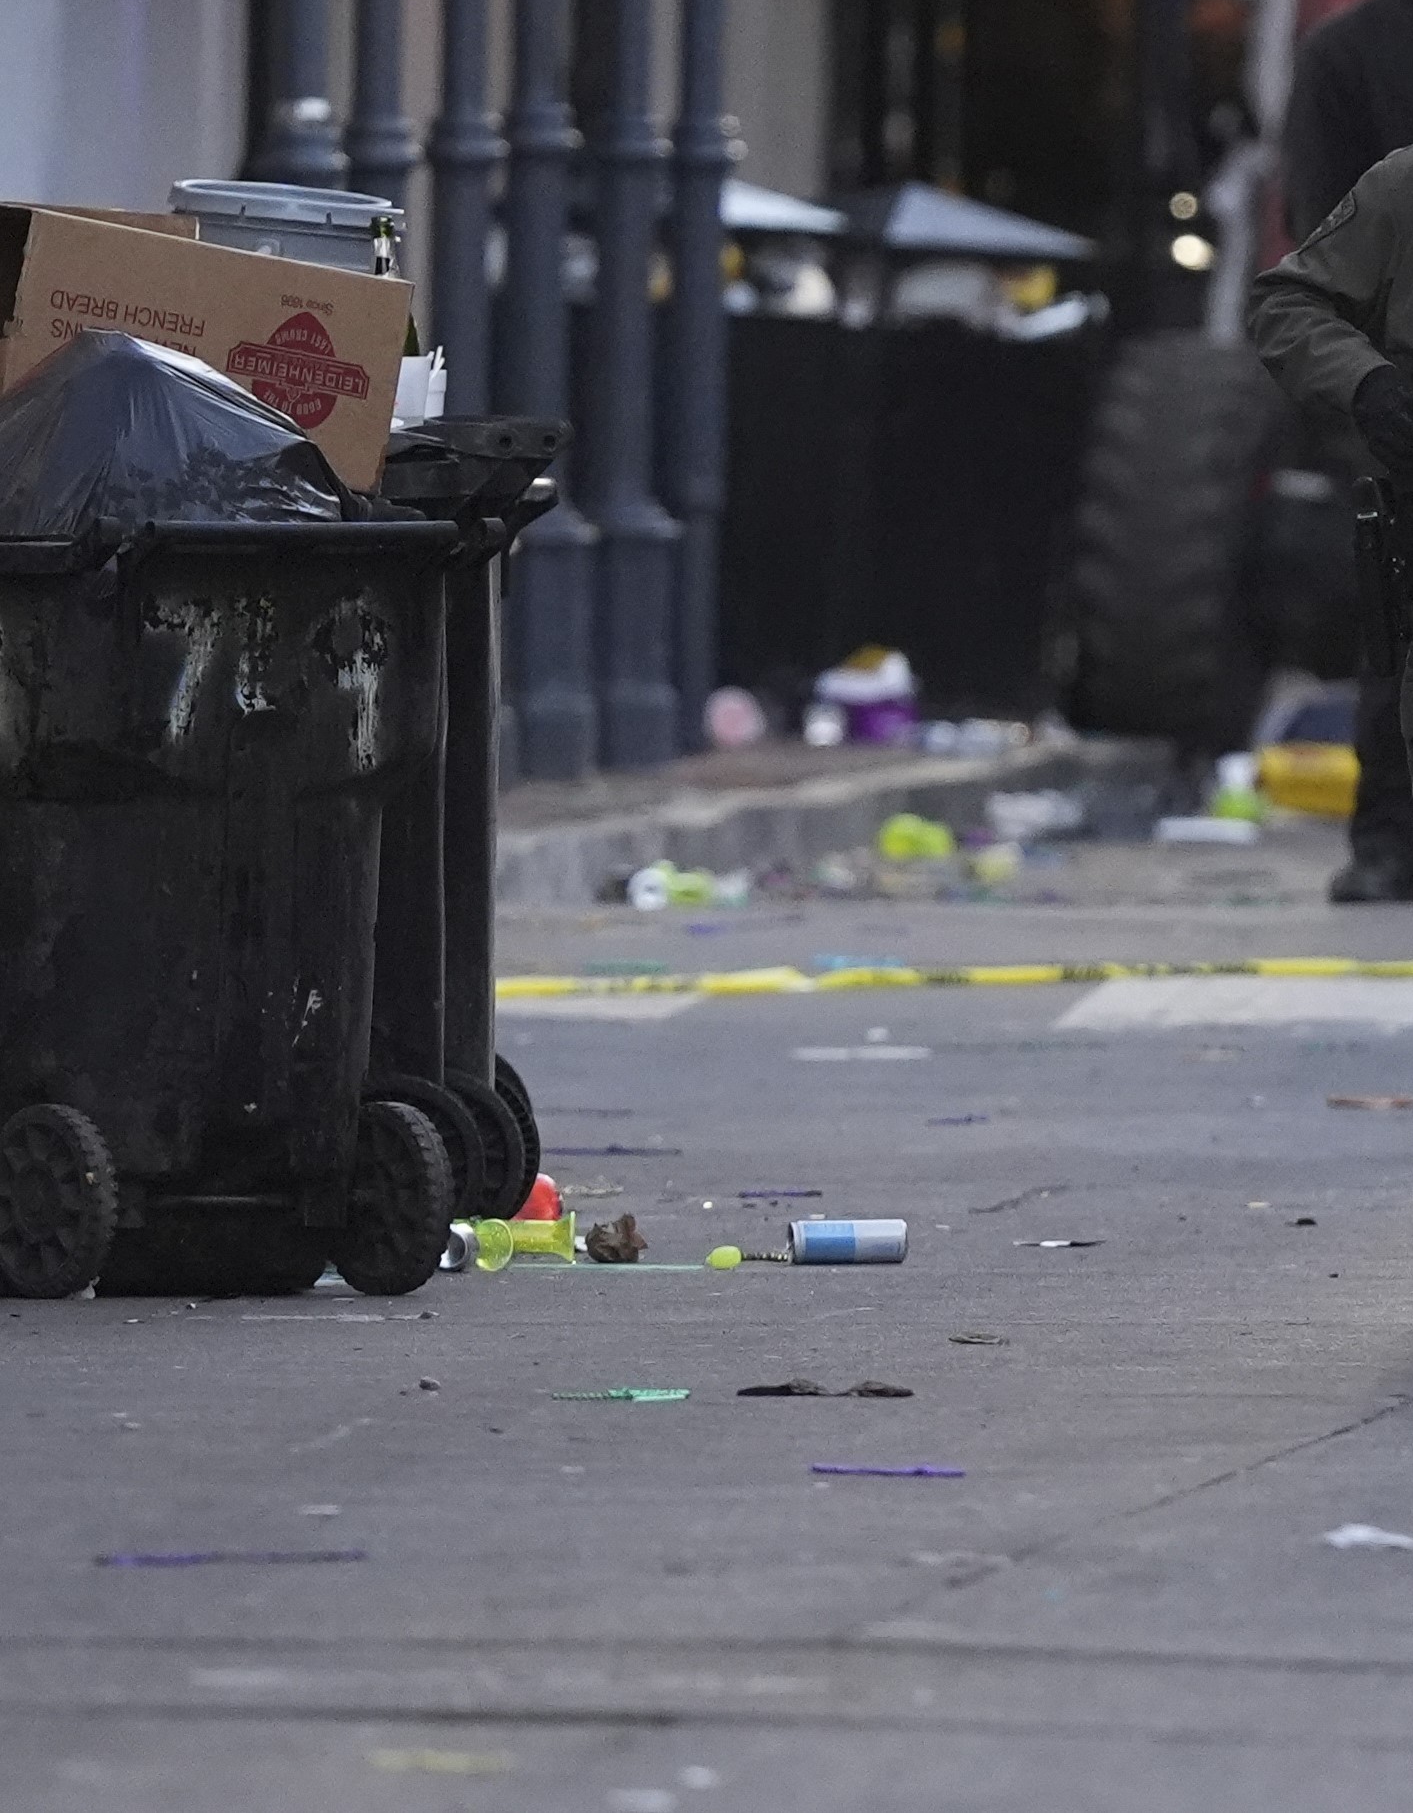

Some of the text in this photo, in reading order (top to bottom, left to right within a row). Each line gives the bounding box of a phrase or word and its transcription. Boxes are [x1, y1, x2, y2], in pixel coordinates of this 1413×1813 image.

[50, 289, 206, 337] FRENCH BREAD
[305, 299, 334, 316] Since
[311, 331, 332, 355] LAST
[234, 353, 364, 394] LEIDENHEIMER
